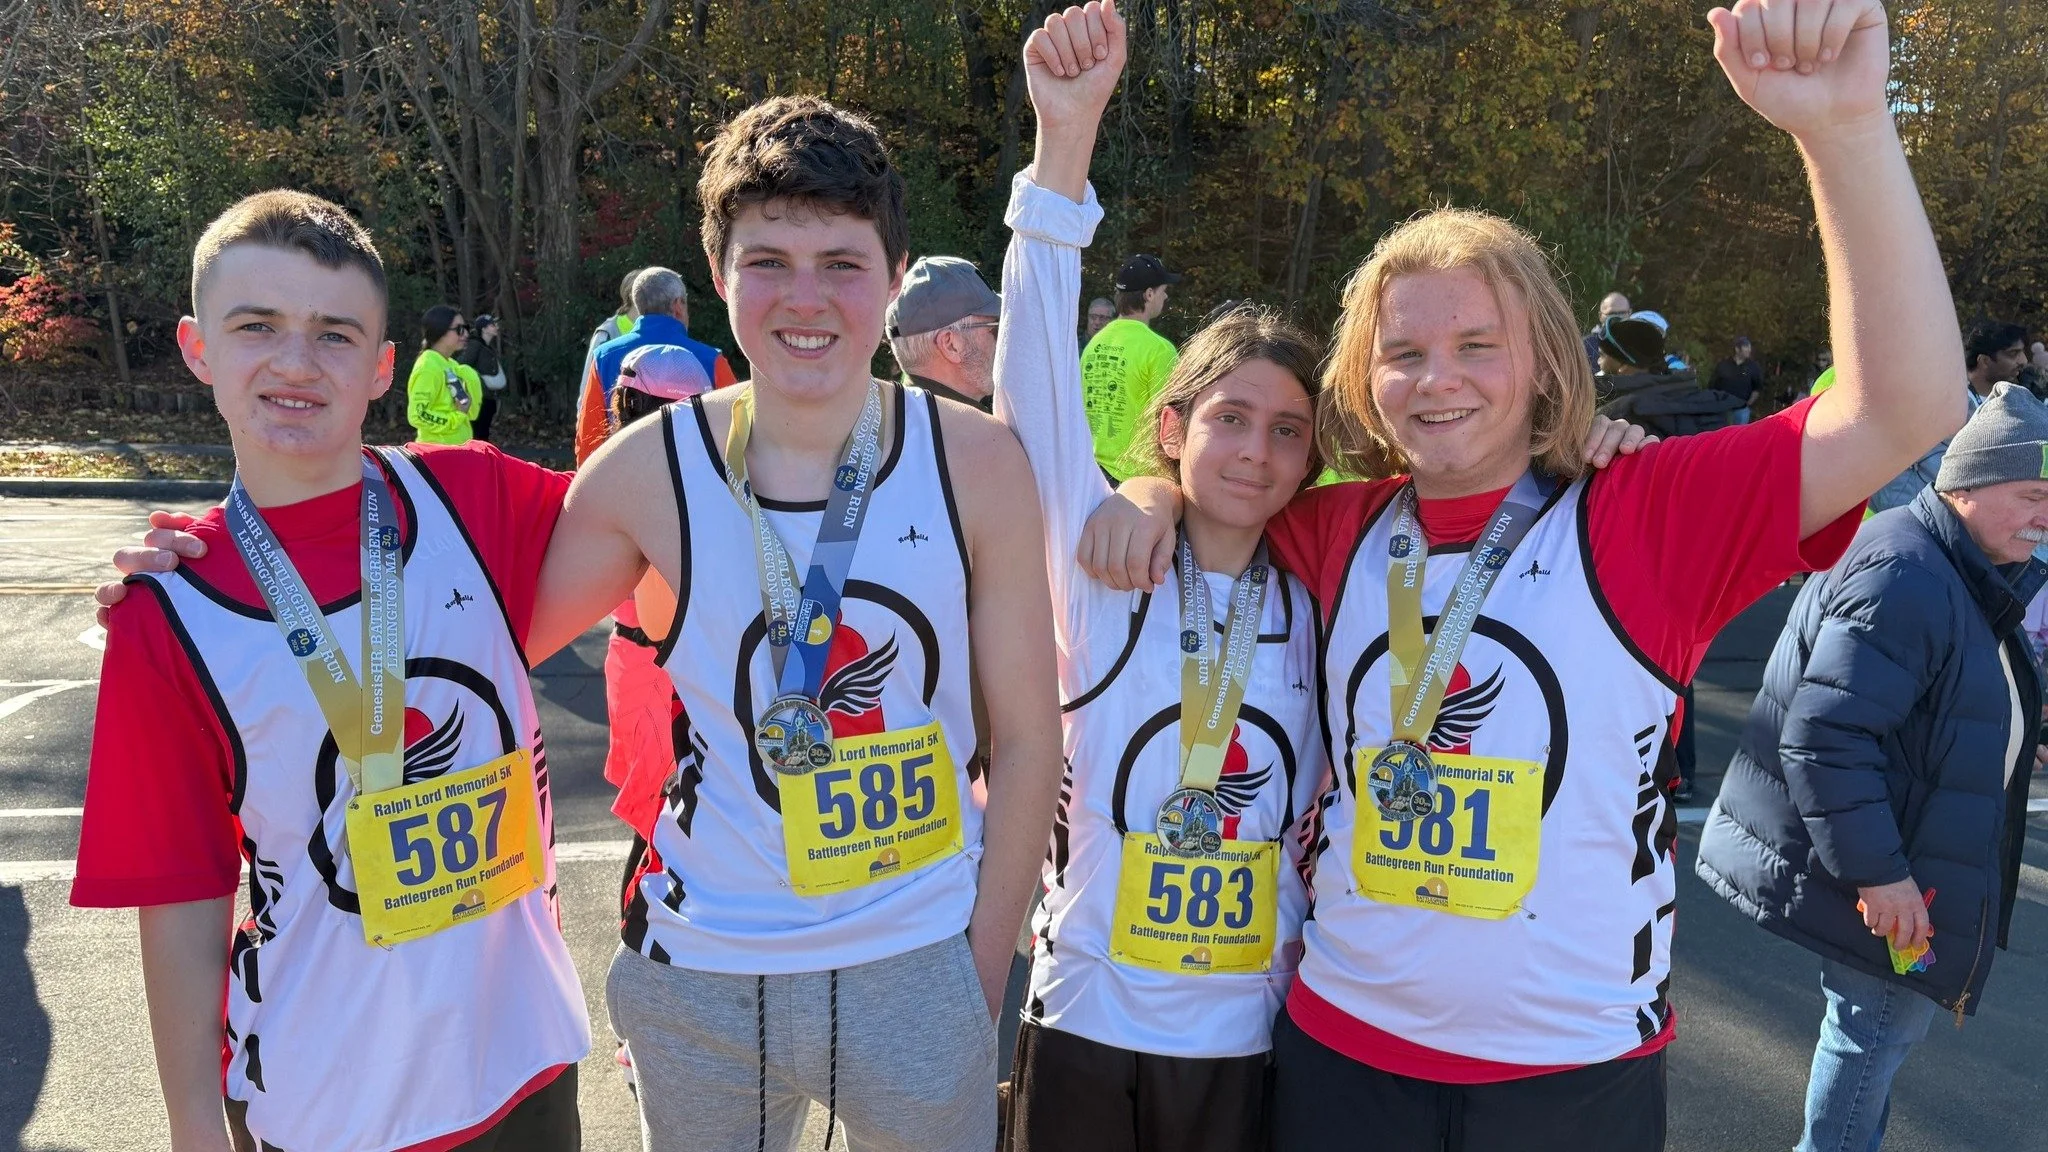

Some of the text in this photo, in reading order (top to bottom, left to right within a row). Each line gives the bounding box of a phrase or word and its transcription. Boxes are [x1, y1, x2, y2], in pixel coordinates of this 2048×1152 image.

[846, 443, 861, 466] MA
[843, 496, 862, 528] RUN
[1398, 516, 1409, 534] MA
[237, 528, 297, 631] LEXINGTON MA
[758, 508, 782, 620] LEXINGTON MA
[1183, 541, 1195, 629] LEXINGTON MA
[1404, 560, 1417, 587] RUN
[259, 538, 328, 650] BATTLEGREEN
[320, 647, 347, 684] RUN
[367, 490, 384, 735] GenesisHR BATTLEGREEN RUN
[384, 552, 399, 668] LEXINGTON MA
[1234, 586, 1261, 678] LEXINGTON MA
[1404, 512, 1513, 727] GenesisHR BATTLEGREEN RUN
[1439, 570, 1494, 674] LEXINGTON MA
[1199, 656, 1208, 686] RUN
[1207, 660, 1234, 730] GenesisHR
[840, 747, 866, 763] Lord
[869, 737, 925, 758] Memorial
[927, 731, 939, 748] 5K
[1435, 763, 1515, 785] Memorial 5K
[373, 764, 512, 818] Ralph Lord Memorial 5K
[814, 752, 936, 840] 585
[388, 787, 507, 887] 587
[807, 817, 947, 861] Battlegreen Run Foundation
[1144, 842, 1174, 858] Ralp
[1365, 851, 1514, 883] Battlegreen Run Foundation
[384, 851, 525, 911] Battlegreen Run Foundation
[1146, 861, 1254, 930] 583
[1130, 924, 1261, 944] Battlegreen Run Foundation
